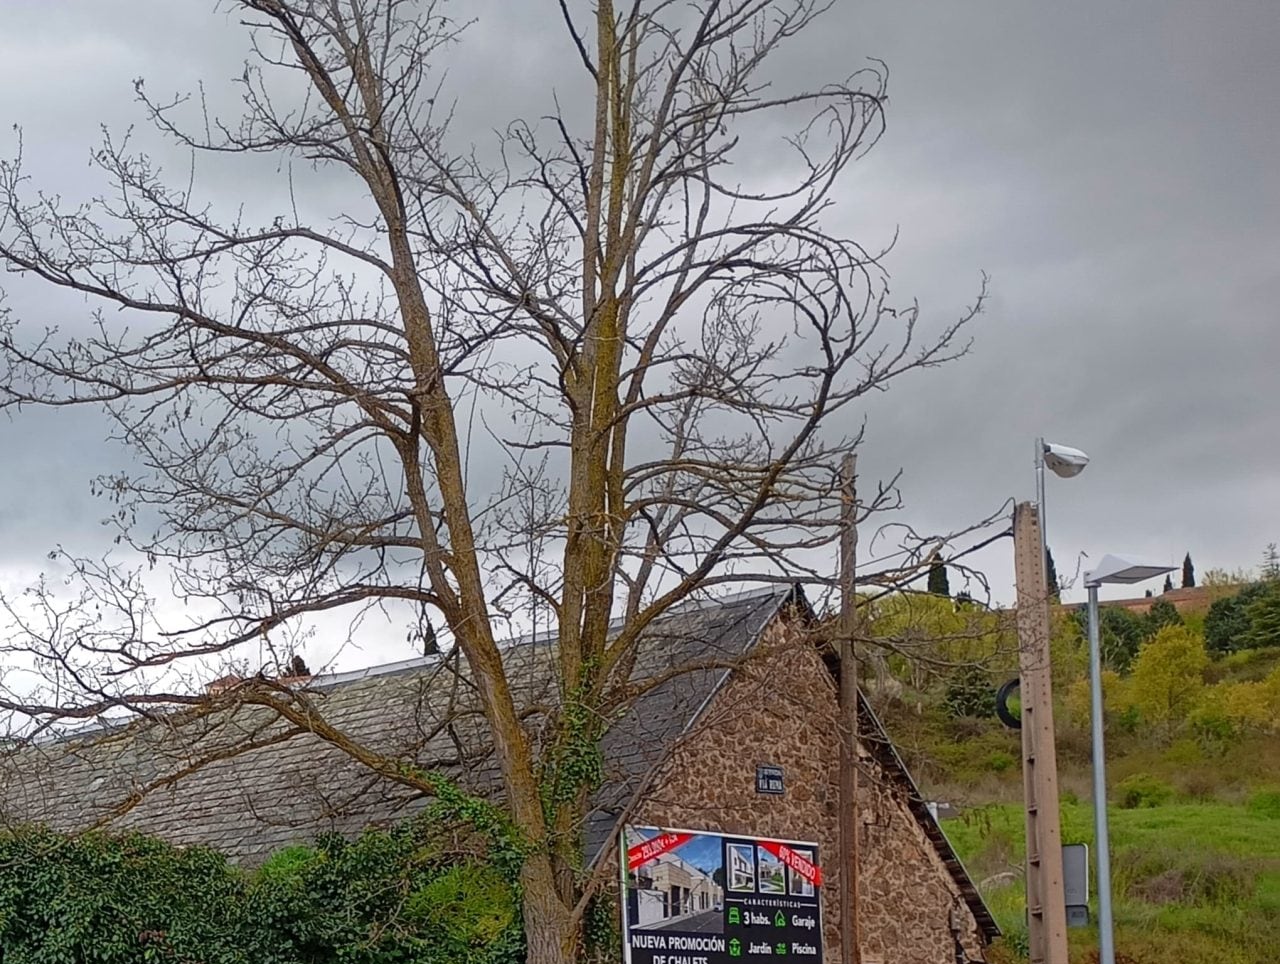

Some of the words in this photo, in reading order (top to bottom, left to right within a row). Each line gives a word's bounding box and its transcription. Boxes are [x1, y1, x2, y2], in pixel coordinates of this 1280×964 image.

[791, 852, 816, 880] VENDIDO
[743, 897, 801, 908] CARACTERÍSTICAS
[743, 911, 750, 925] 3
[751, 911, 772, 925] habs.
[791, 914, 816, 930] Garaje
[631, 934, 667, 949] NUEVA
[668, 936, 726, 952] PROMOCIÓN
[748, 942, 772, 955] Jardín
[791, 942, 817, 955] Piscina
